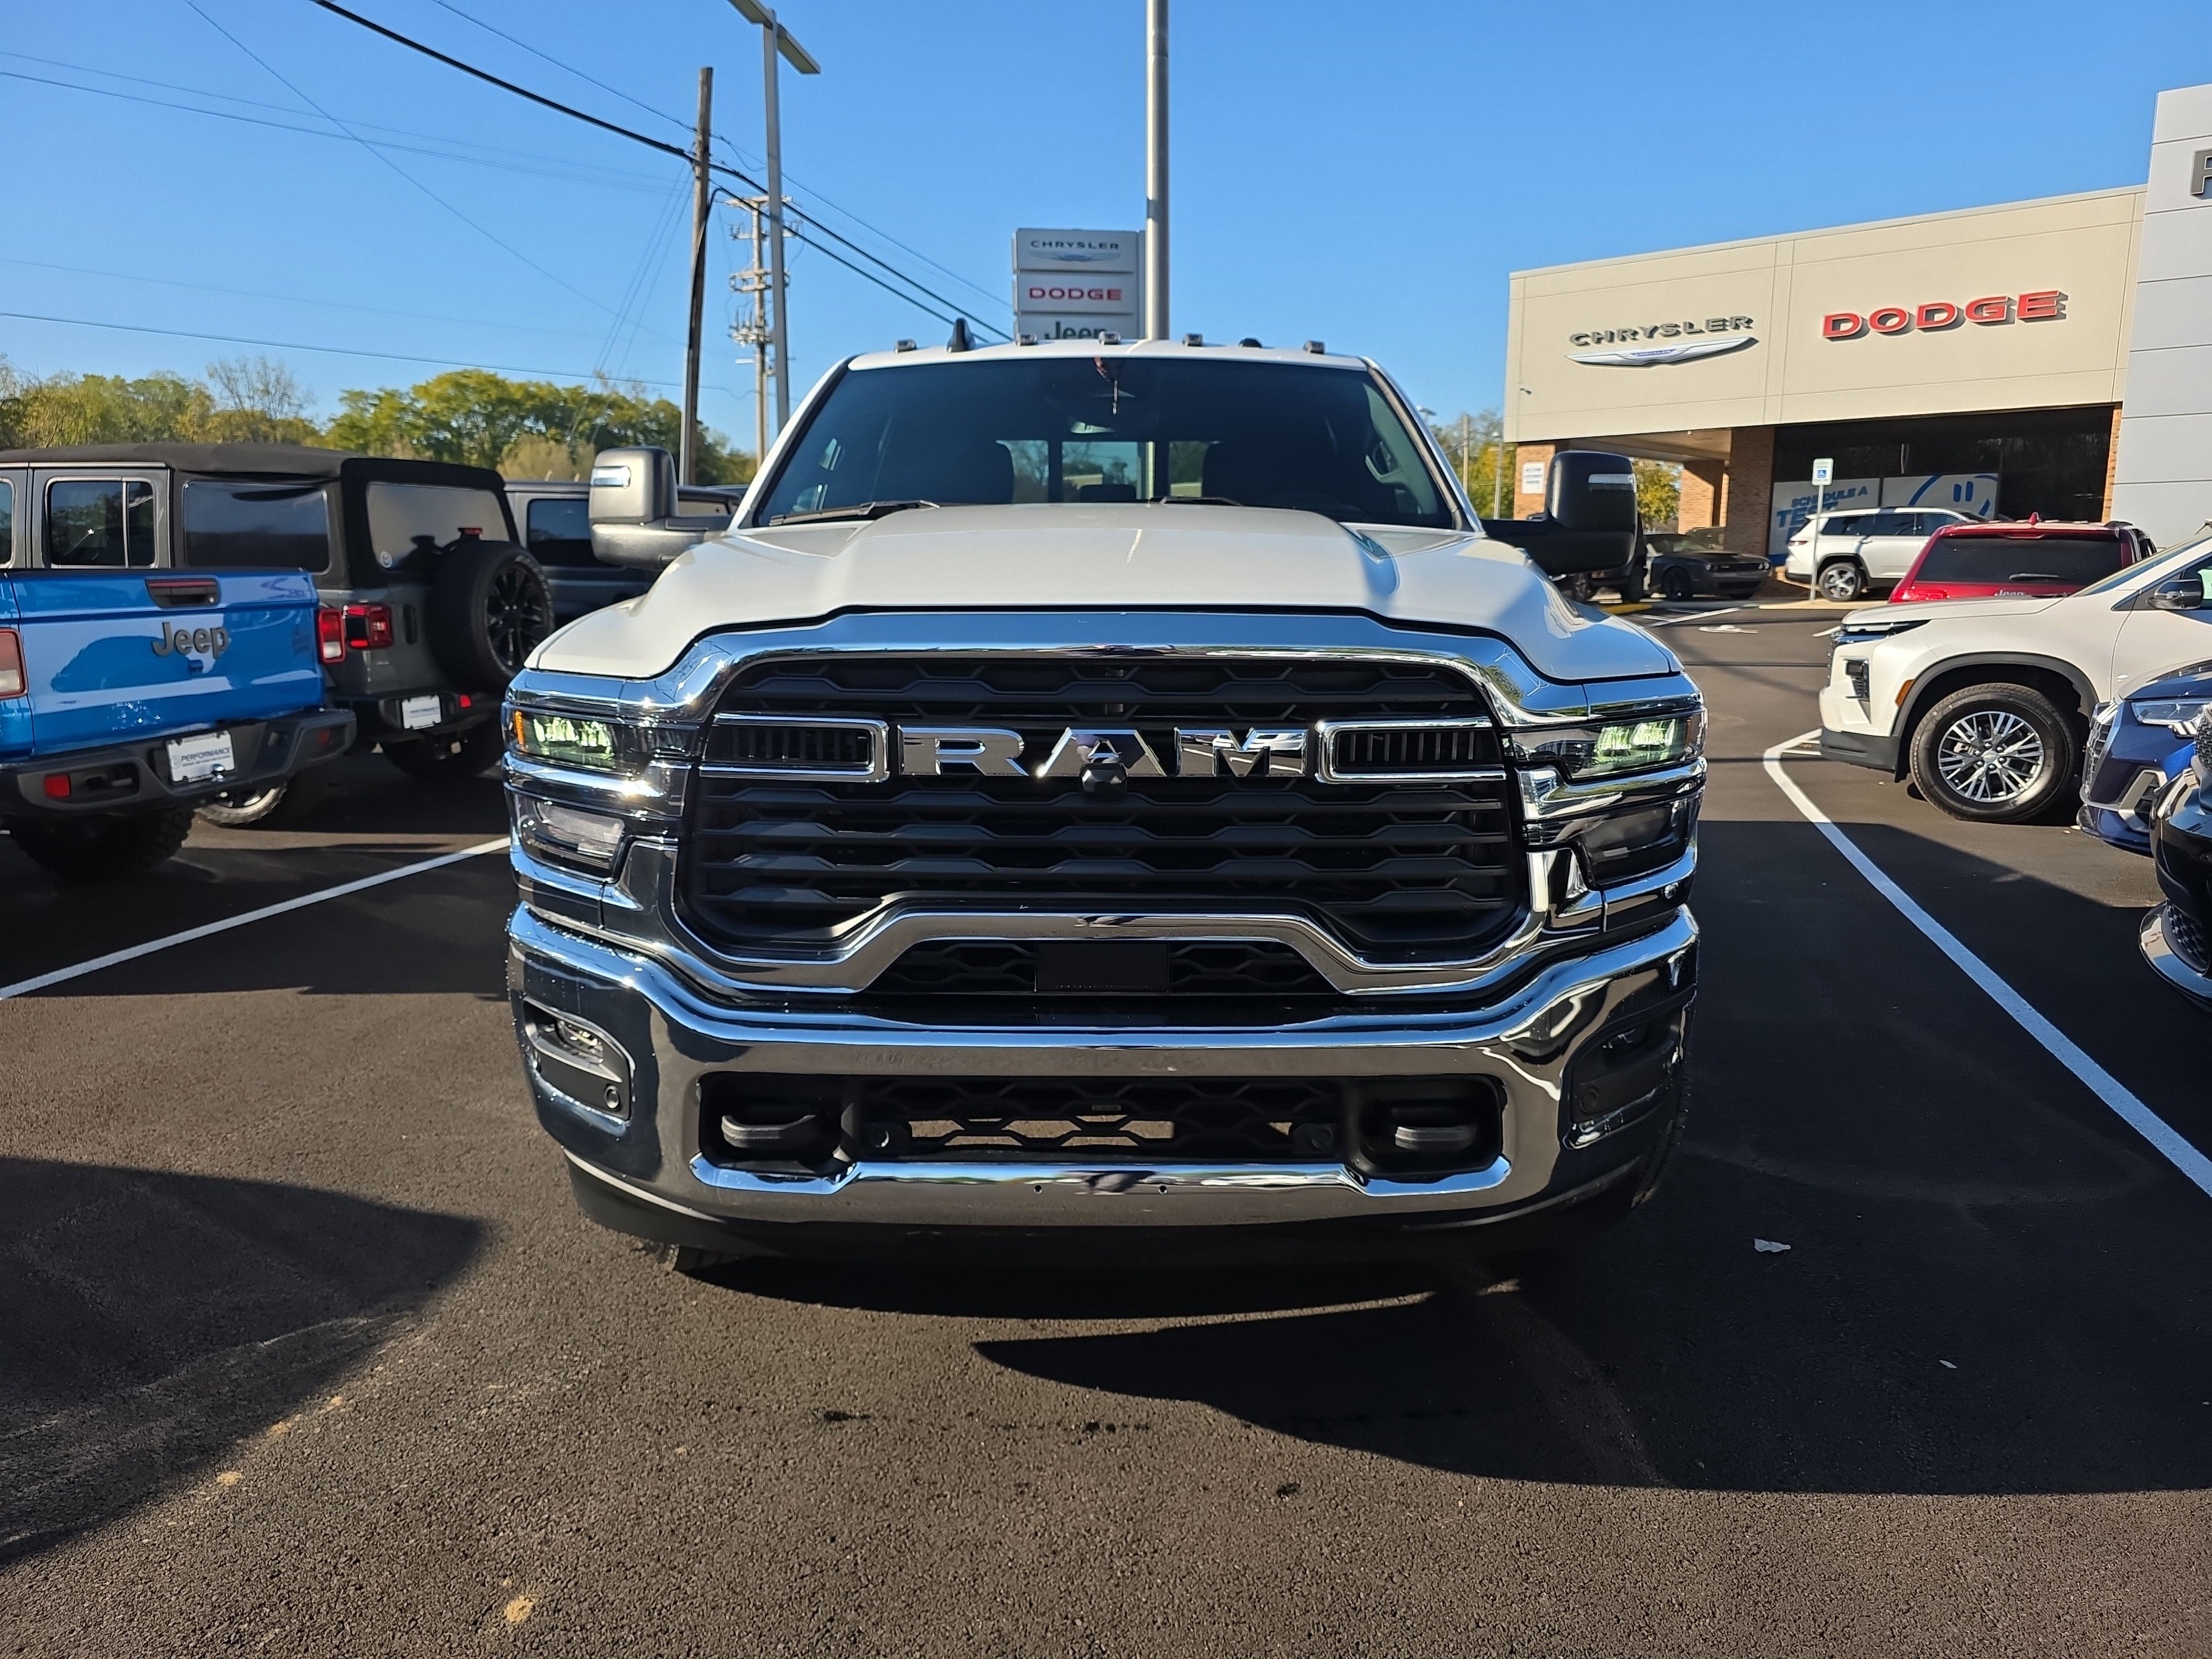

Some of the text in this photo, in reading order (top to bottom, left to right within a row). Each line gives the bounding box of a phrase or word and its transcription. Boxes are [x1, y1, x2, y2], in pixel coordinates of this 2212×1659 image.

[1031, 240, 1119, 250] CHRYSLER
[1030, 288, 1122, 300] DODGE
[1822, 290, 2060, 338] DODGE
[1571, 316, 1753, 346] CHRYSLER
[1857, 486, 1868, 497] A
[152, 622, 228, 659] Jeep
[897, 726, 1308, 777] RAM
